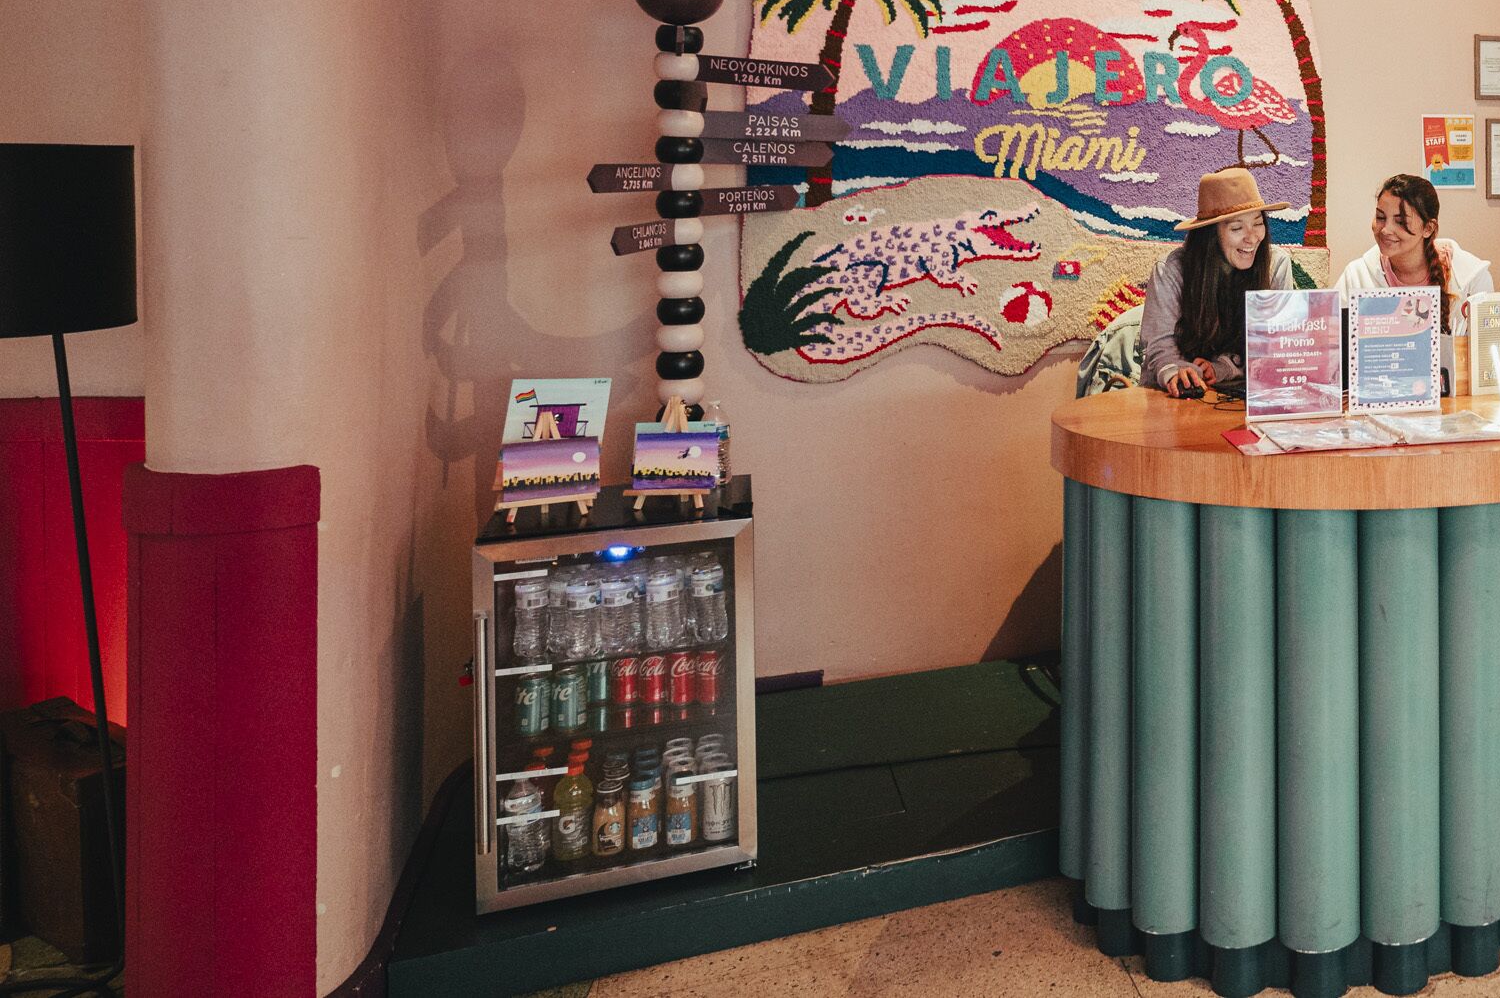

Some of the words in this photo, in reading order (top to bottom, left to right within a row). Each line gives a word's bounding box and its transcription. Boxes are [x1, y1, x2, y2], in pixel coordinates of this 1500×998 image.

[710, 58, 809, 79] NEOYORKINOS
[855, 42, 1256, 105] VIAJERO
[734, 73, 761, 85] 1,286
[764, 75, 782, 86] Km
[748, 114, 799, 128] PAISAS
[745, 127, 778, 138] 2,224
[782, 127, 801, 138] Km
[733, 140, 796, 156] CALEÑOS
[1425, 137, 1446, 146] STAFF
[973, 119, 1147, 181] Miami
[742, 153, 767, 164] 2,511
[769, 154, 787, 165] Km
[615, 166, 662, 179] ANGELINOS
[642, 178, 654, 190] Km
[718, 189, 776, 204] PORTEÑOS
[729, 202, 751, 214] 7,091
[753, 200, 767, 212] Km
[654, 236, 663, 247] Km
[1489, 305, 1500, 315] NO
[1267, 317, 1328, 334] Breakfast
[1280, 336, 1315, 349] Promo
[1282, 376, 1288, 384] $
[1289, 375, 1307, 384] 6.99
[639, 655, 665, 677] Cola
